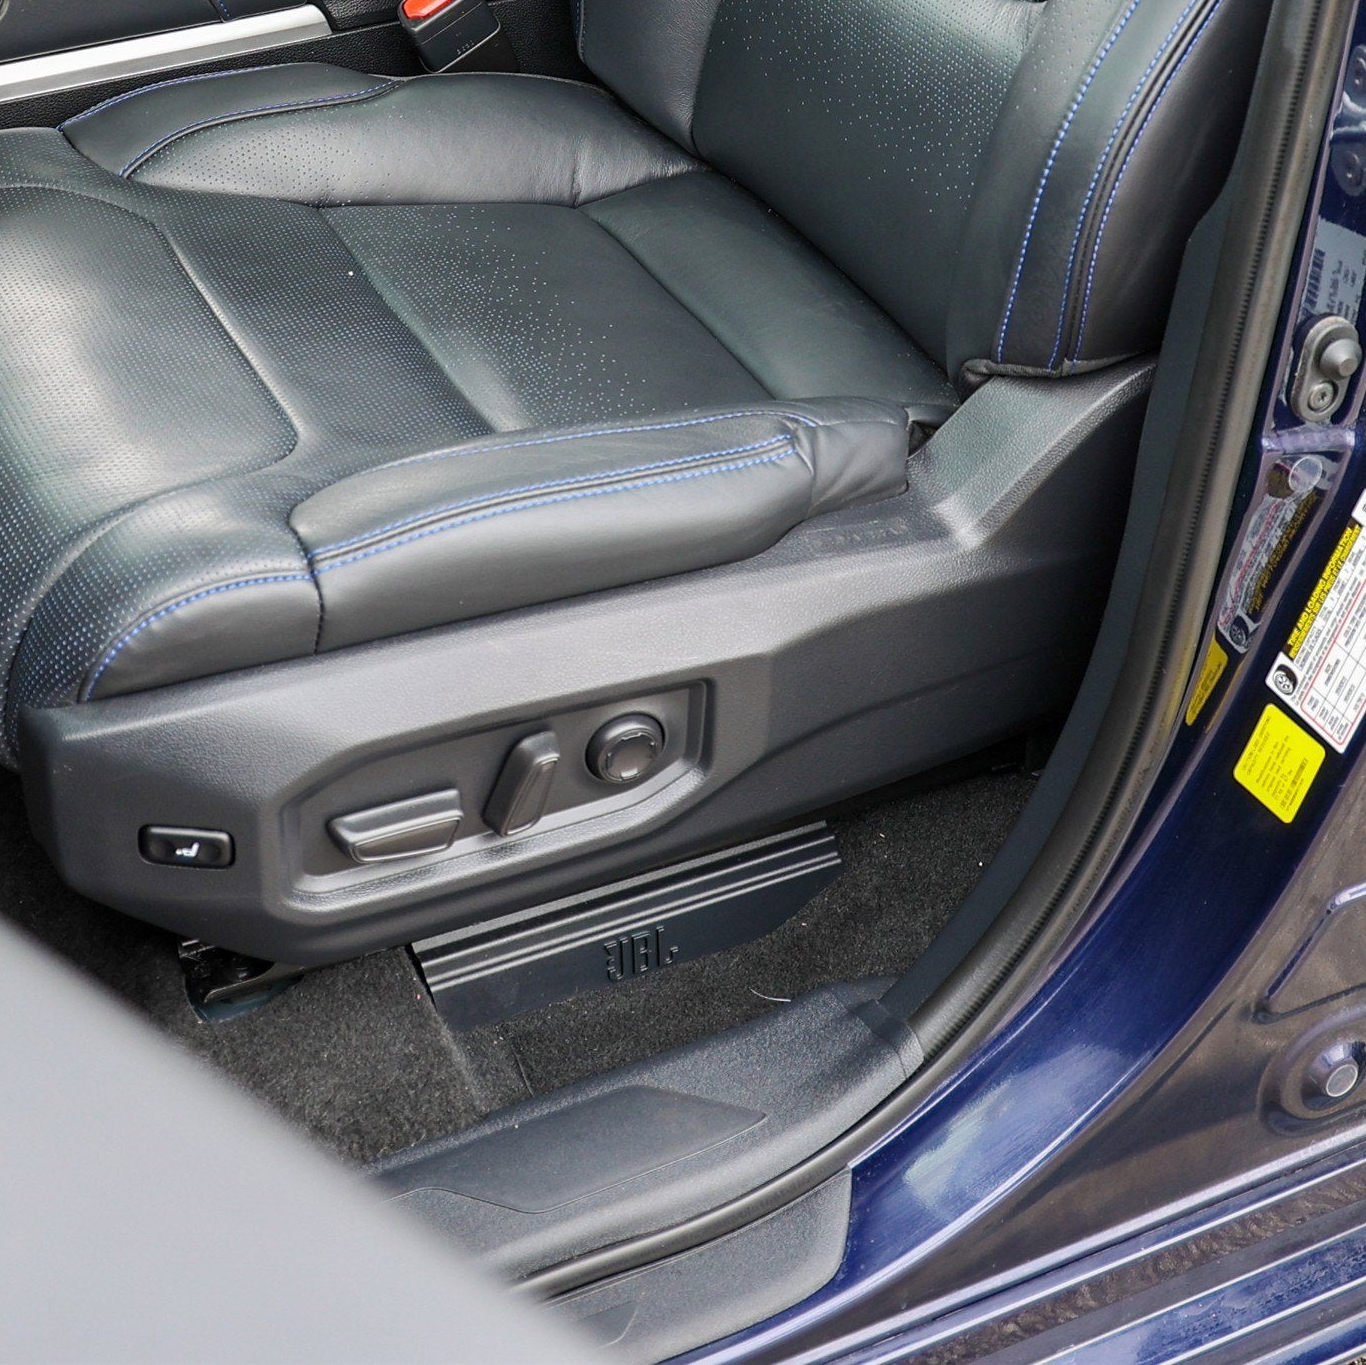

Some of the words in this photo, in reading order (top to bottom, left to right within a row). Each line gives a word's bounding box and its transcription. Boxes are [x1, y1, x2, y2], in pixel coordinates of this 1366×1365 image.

[1286, 626, 1300, 647] TIRE
[1295, 610, 1309, 631] AND
[1304, 577, 1326, 614] LOADING
[1321, 525, 1352, 581] INFORMATION
[604, 925, 679, 980] JBL
